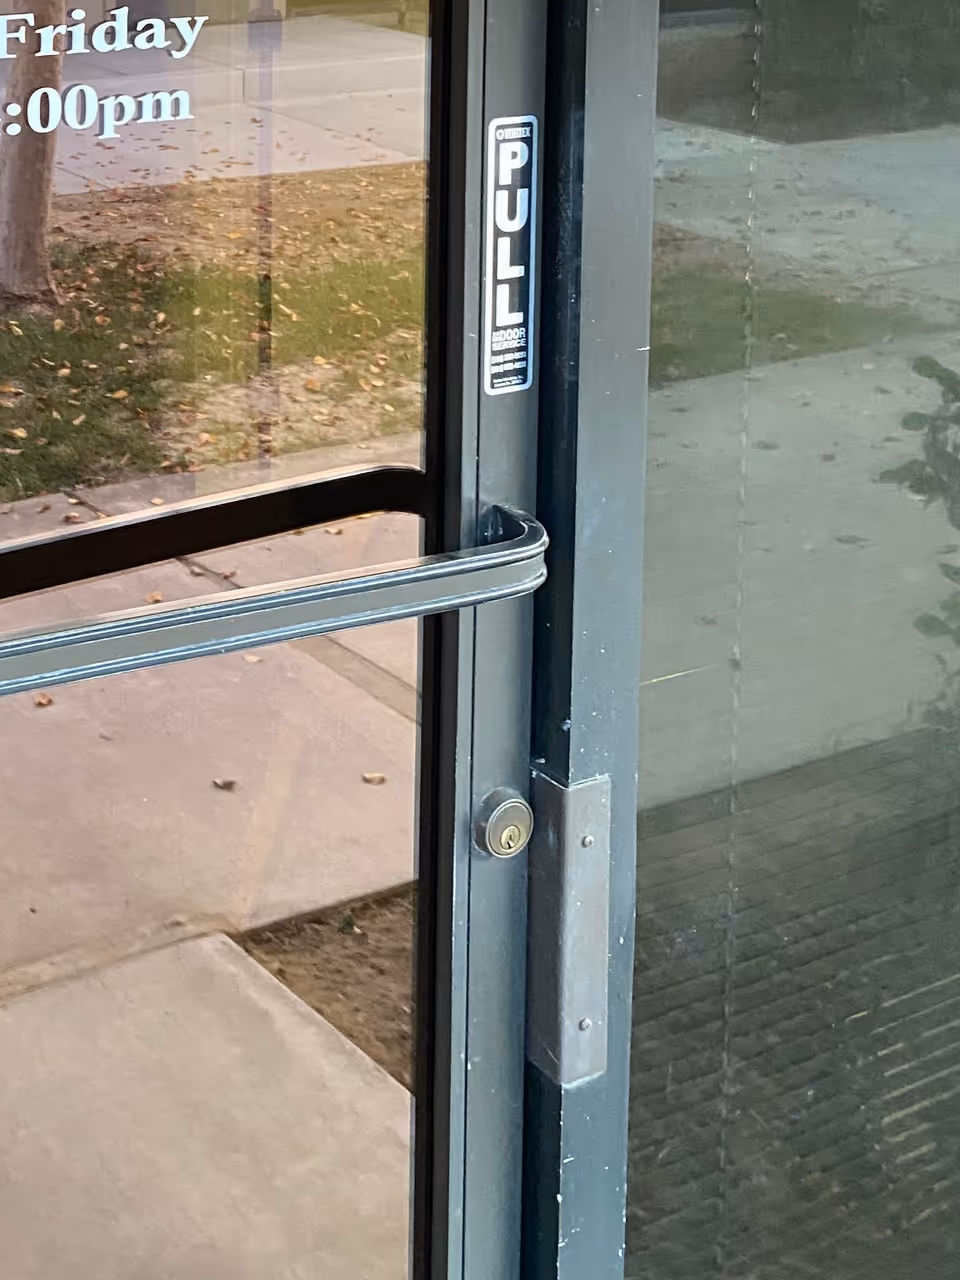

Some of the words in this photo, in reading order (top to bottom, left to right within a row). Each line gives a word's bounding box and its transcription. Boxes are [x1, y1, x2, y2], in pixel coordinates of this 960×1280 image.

[495, 141, 529, 327] PULL
[499, 328, 526, 342] DOOR
[492, 338, 527, 351] SERVICE
